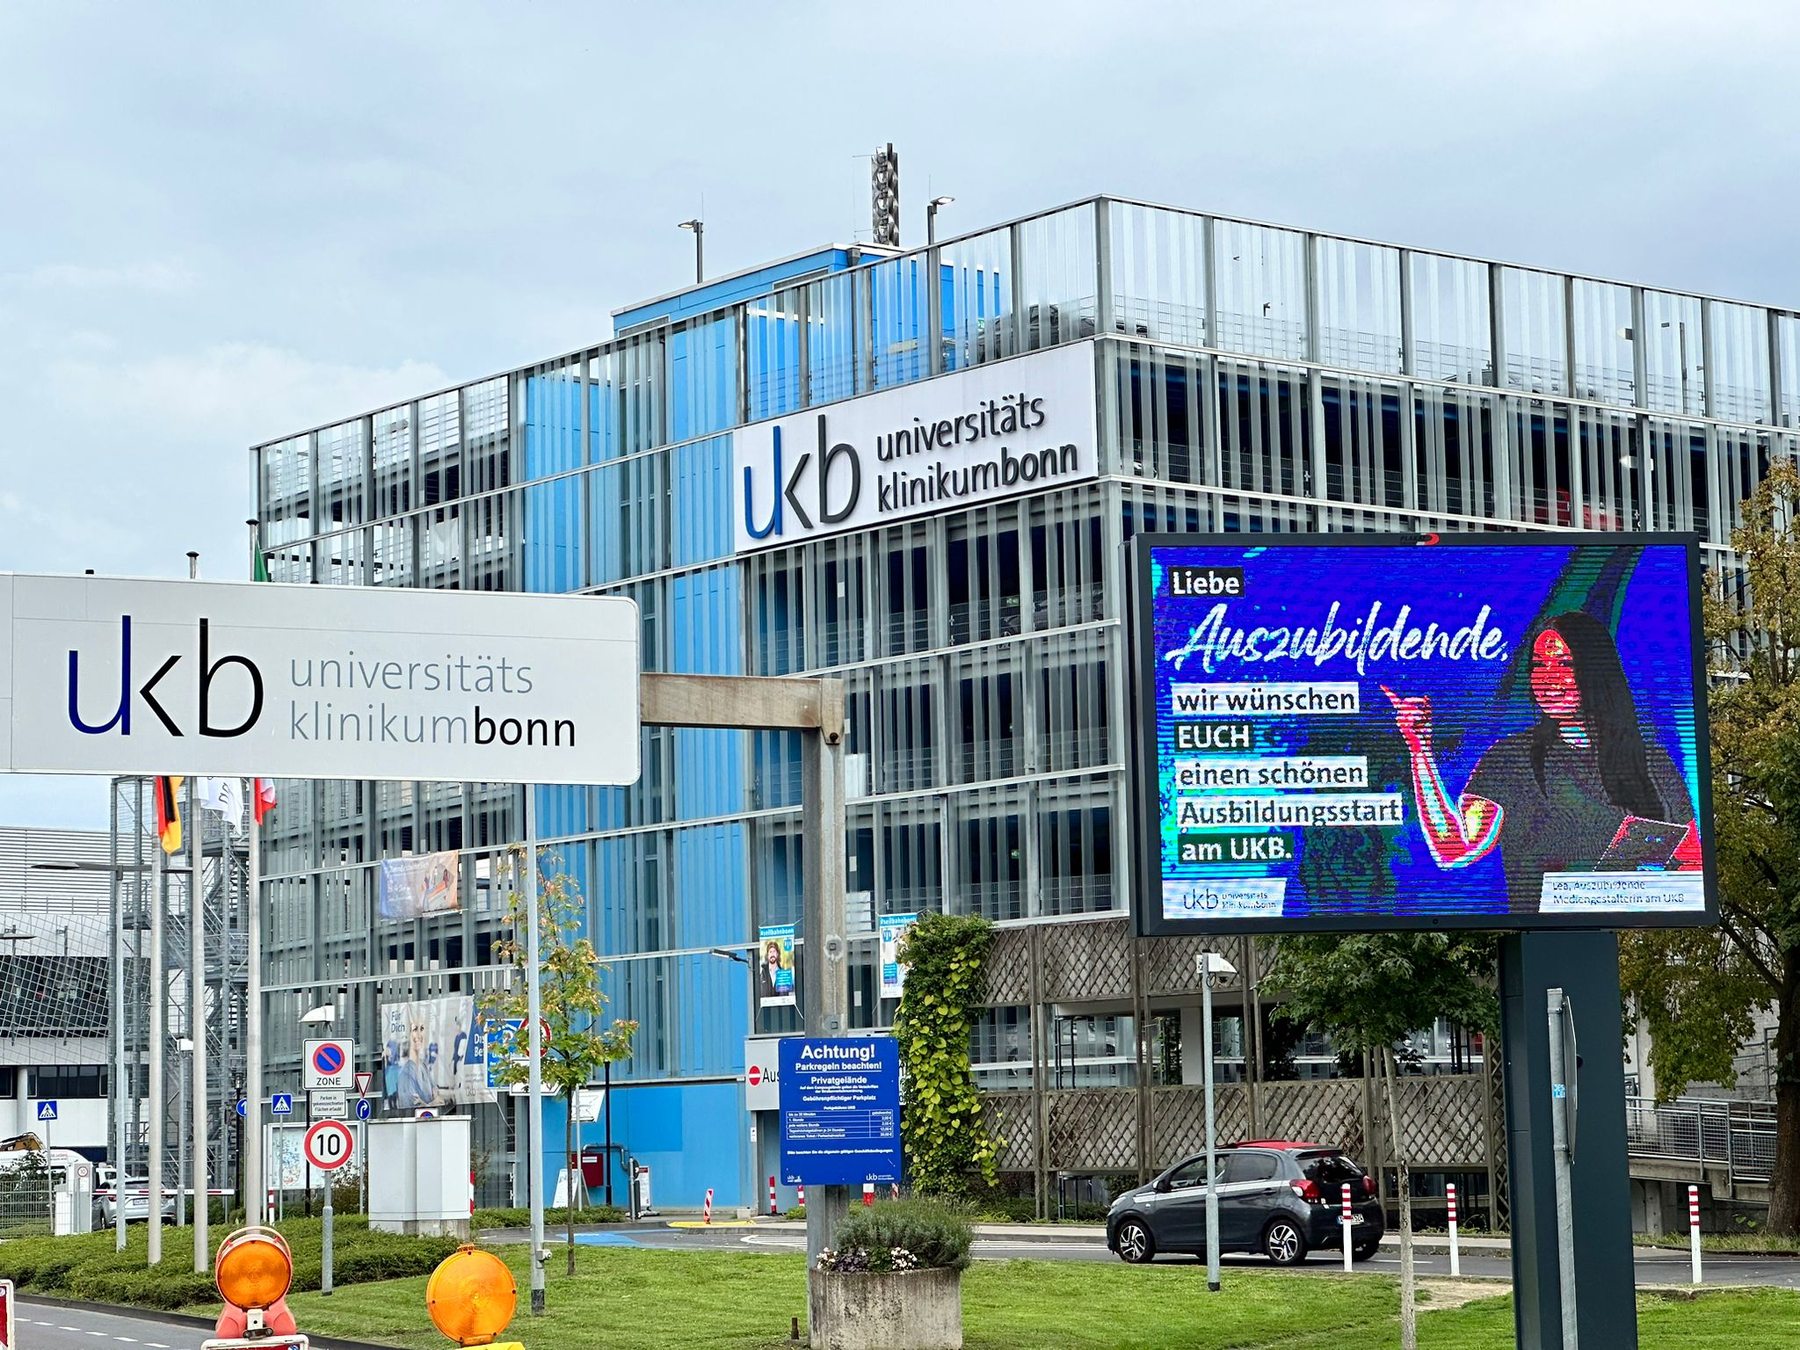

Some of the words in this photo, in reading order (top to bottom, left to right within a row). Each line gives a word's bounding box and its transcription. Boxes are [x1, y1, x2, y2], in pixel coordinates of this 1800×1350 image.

[876, 392, 1045, 462] universitäts
[744, 414, 861, 539] ukb
[877, 442, 1078, 513] klinikumbonn
[1173, 571, 1240, 595] Liebe
[67, 614, 265, 738] ukb
[290, 651, 534, 694] universitäts
[1176, 688, 1219, 712] wir
[1225, 687, 1355, 711] wünschen
[290, 701, 576, 748] klinikumbonn
[1178, 724, 1250, 748] EUCH
[1180, 763, 1250, 785] einen
[1258, 761, 1363, 785] schönen
[1179, 799, 1402, 827] Ausbildungsstart
[1182, 843, 1222, 861] am
[1230, 837, 1292, 861] UKB.
[1183, 888, 1219, 910] ukb
[1645, 895, 1661, 904] am
[800, 1043, 875, 1061] Achtung!
[795, 1062, 840, 1072] Parkregeln
[841, 1061, 882, 1070] beachten!
[316, 1077, 341, 1086] ZONE
[811, 1076, 867, 1085] Privatgelände
[317, 1133, 340, 1156] 10
